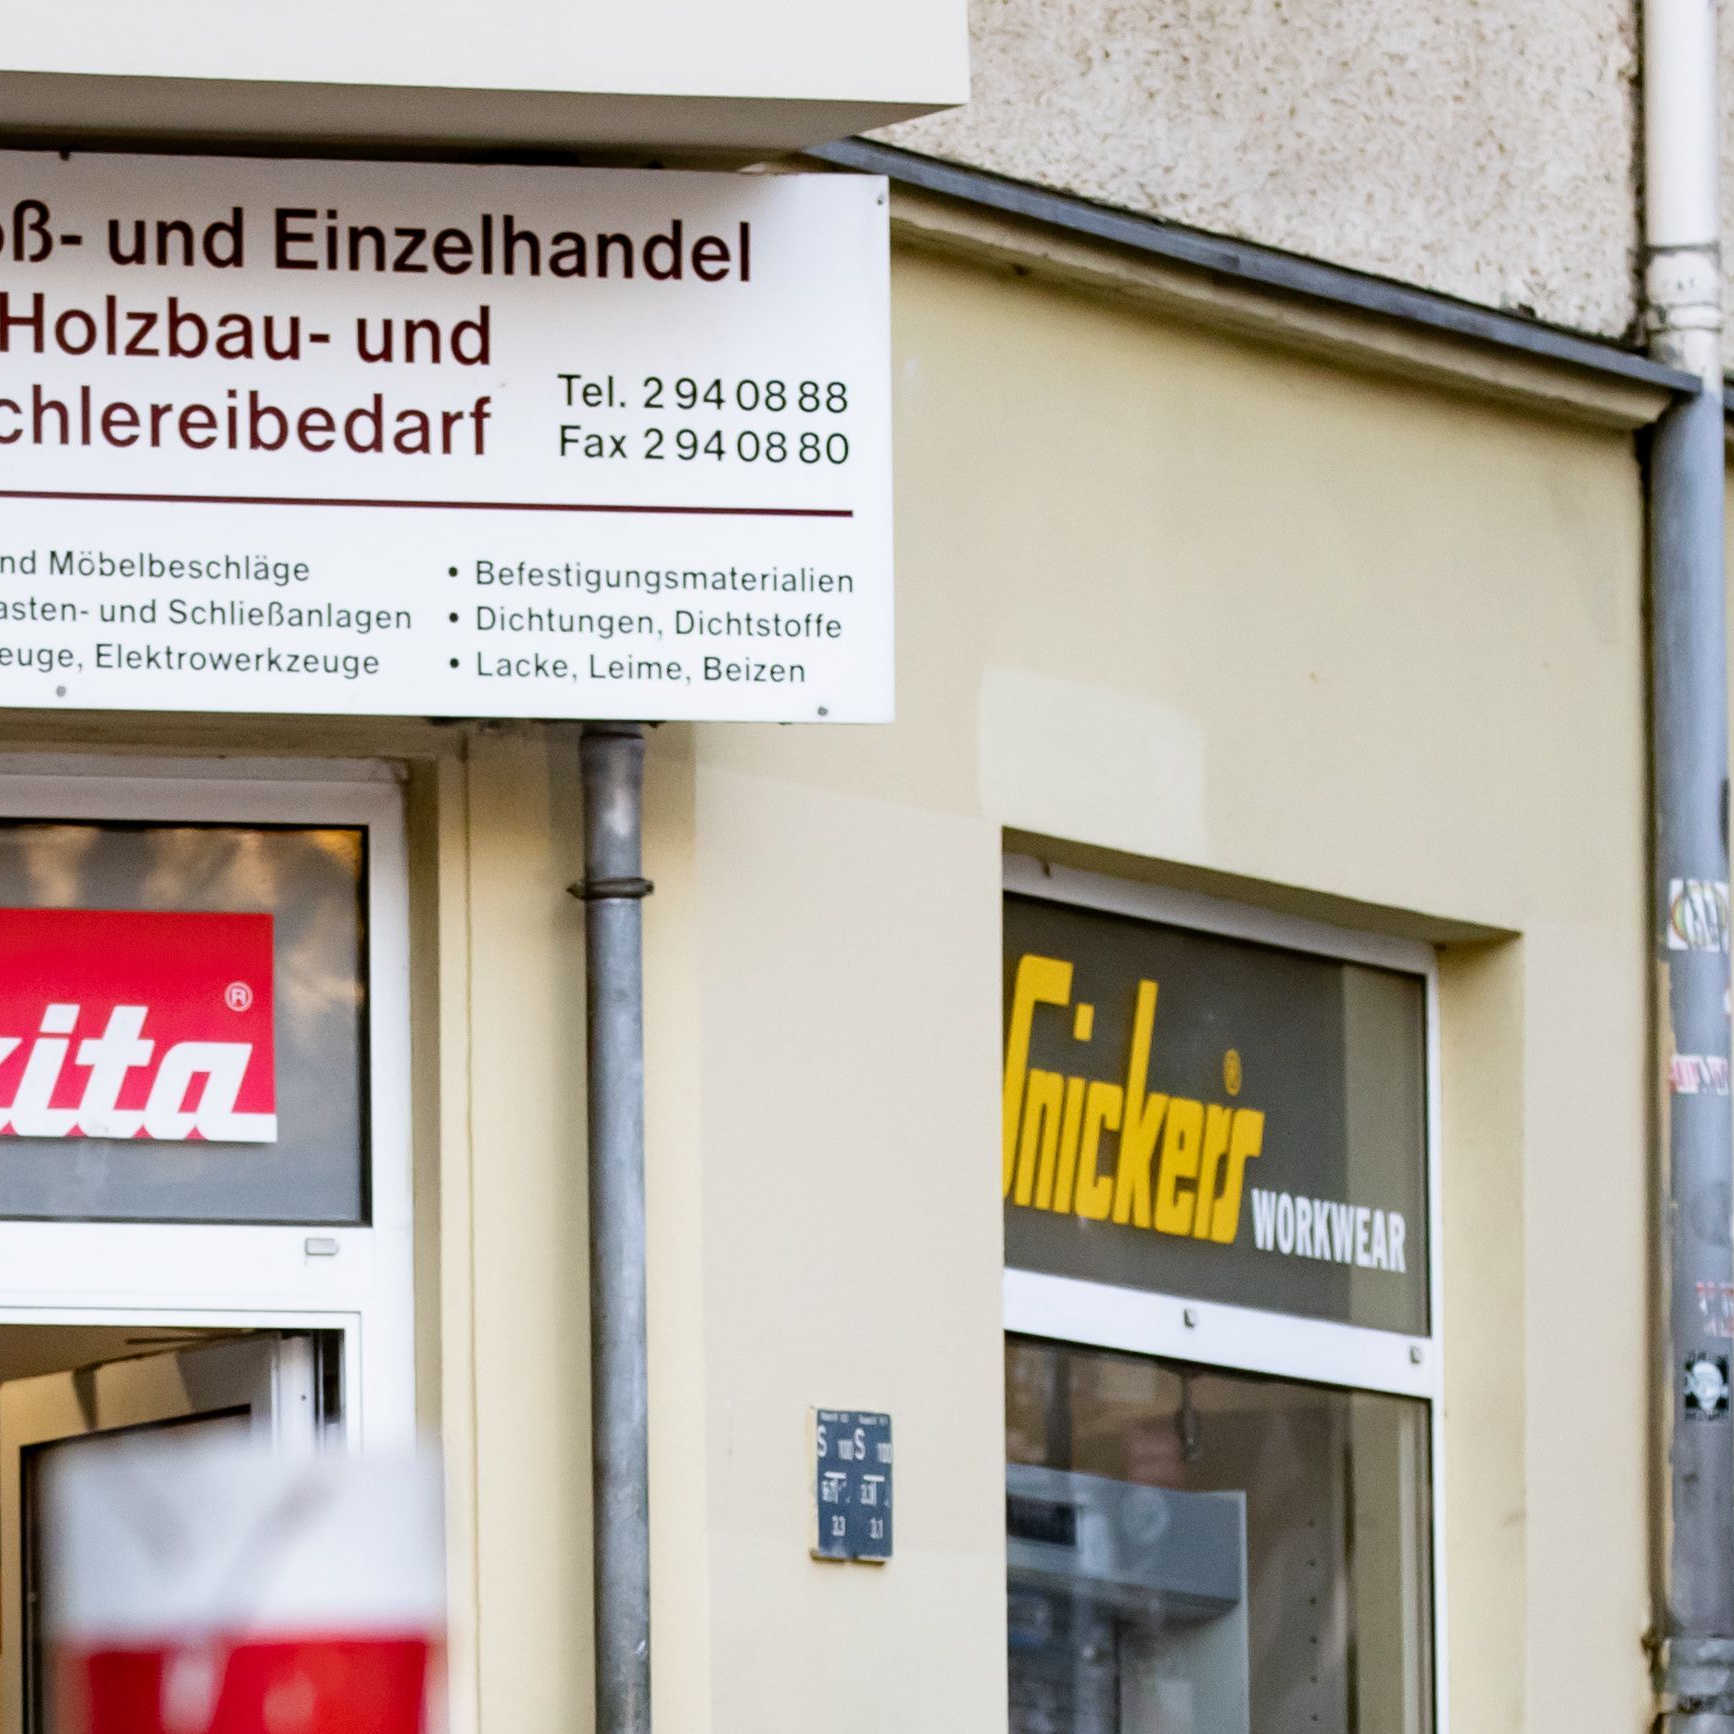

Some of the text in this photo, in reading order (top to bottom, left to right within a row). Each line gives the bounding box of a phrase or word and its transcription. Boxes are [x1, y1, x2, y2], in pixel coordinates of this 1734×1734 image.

[108, 206, 245, 269] und
[274, 207, 751, 282] Einzelhandel
[356, 304, 492, 367] und
[557, 373, 627, 409] Tel.
[559, 424, 628, 459] Fax
[48, 550, 310, 587] Möbelbeschläge
[475, 559, 854, 596] Befestigungsmaterialien
[100, 598, 157, 625] und
[167, 598, 412, 636] Schließanlagen
[475, 605, 843, 640] Dichtungen, Dichtstoffe
[94, 643, 380, 681] Elektrowerkzeuge
[476, 651, 806, 684] Lacke, Leime, Beizen
[1251, 1187, 1408, 1275] WORKWEAR
